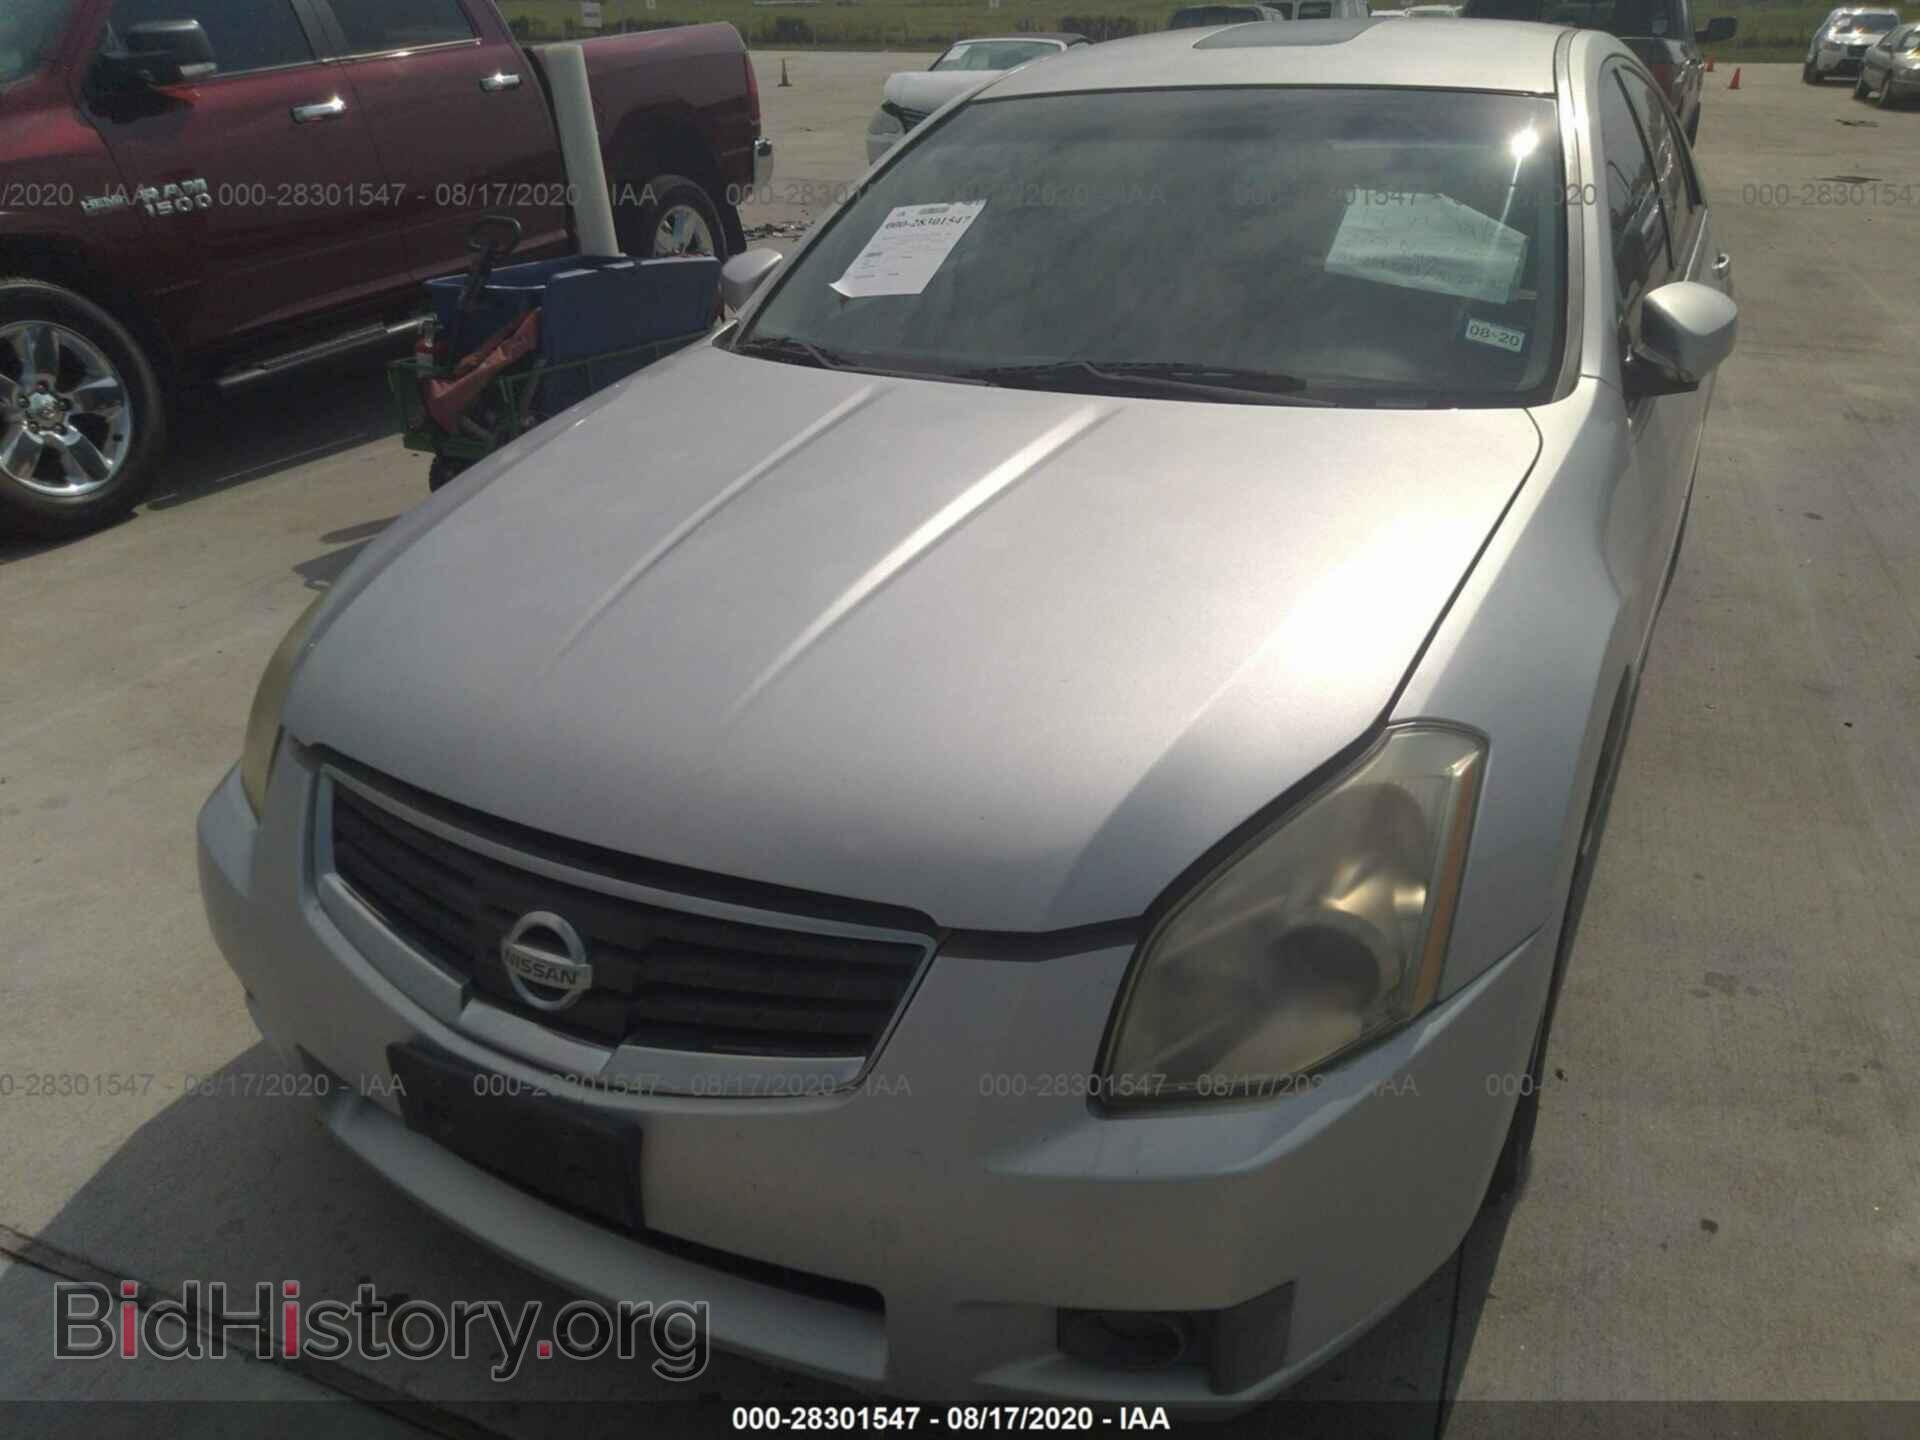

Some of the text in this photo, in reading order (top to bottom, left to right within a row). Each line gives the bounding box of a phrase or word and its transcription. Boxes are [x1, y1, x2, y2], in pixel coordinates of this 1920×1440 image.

[142, 177, 208, 203] RAM
[144, 193, 212, 216] 1500
[1471, 322, 1520, 346] 08-20
[504, 950, 578, 985] NISSAN
